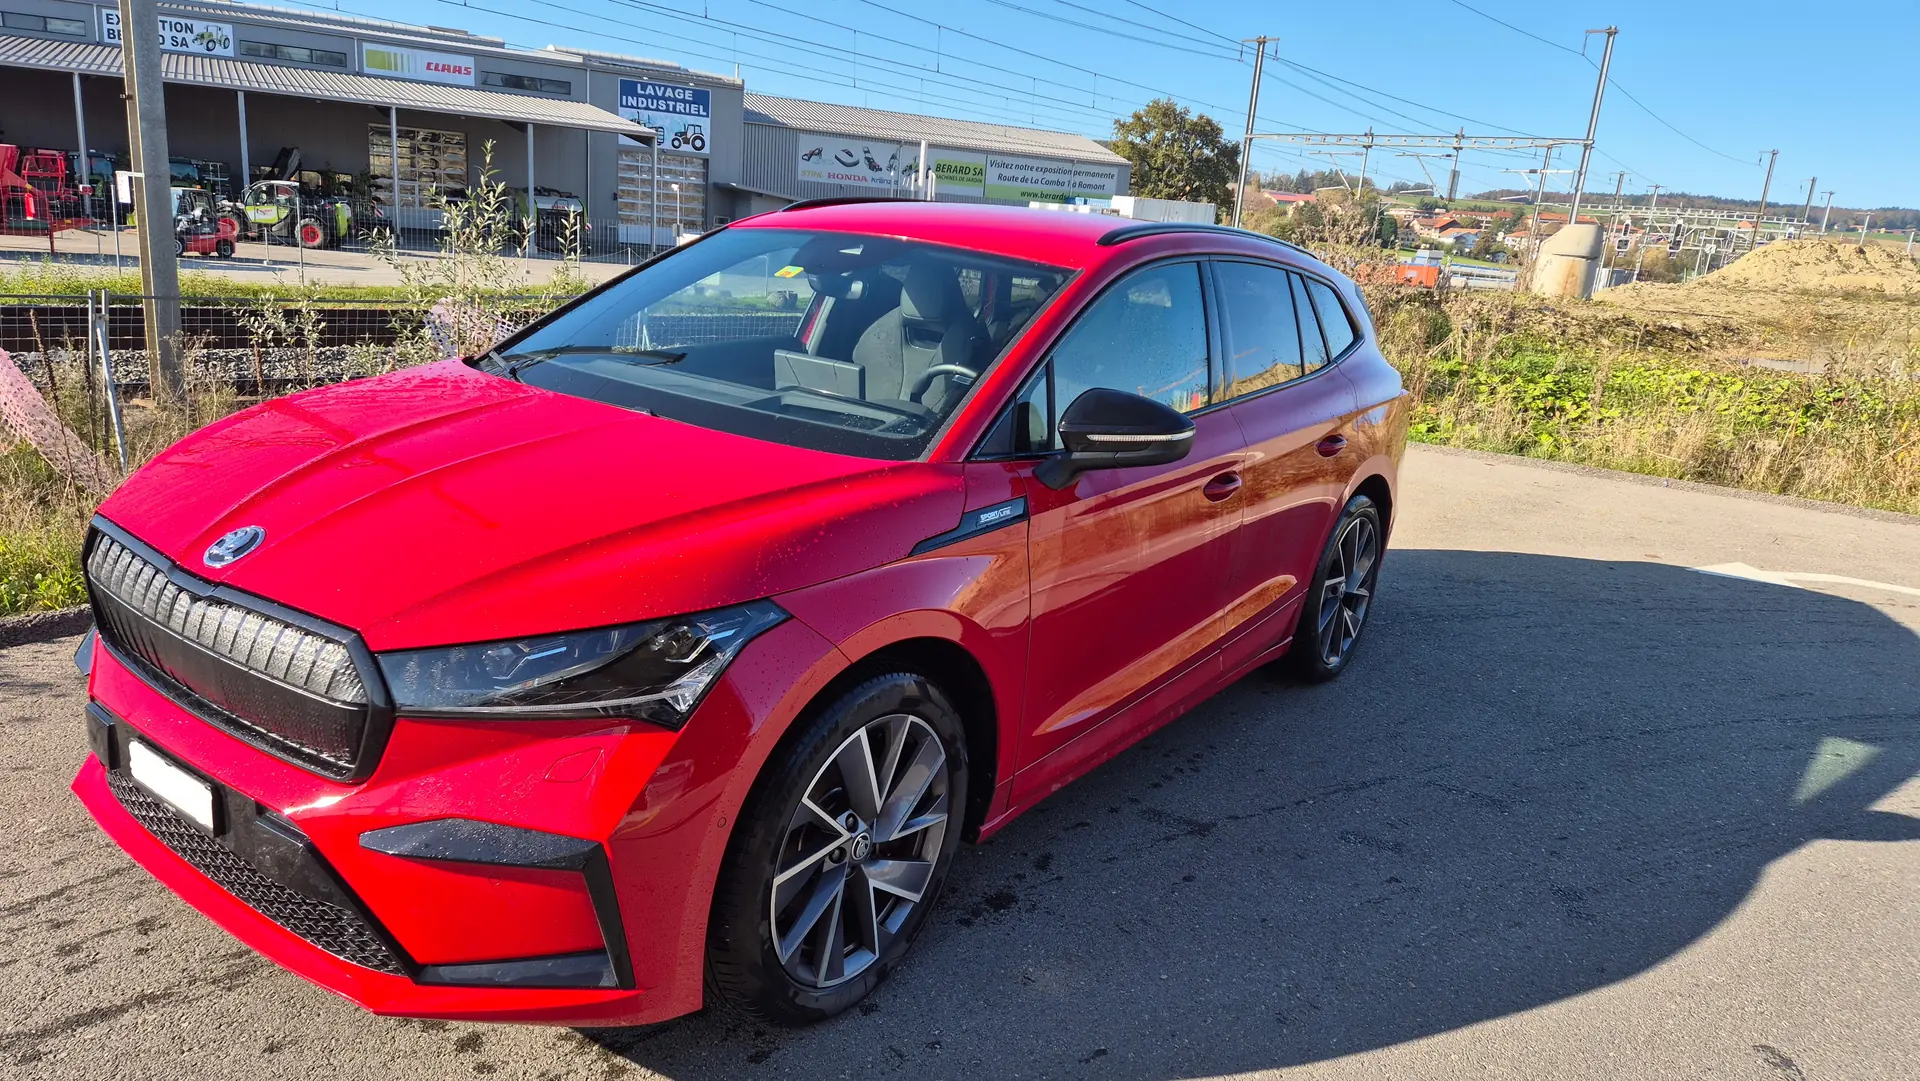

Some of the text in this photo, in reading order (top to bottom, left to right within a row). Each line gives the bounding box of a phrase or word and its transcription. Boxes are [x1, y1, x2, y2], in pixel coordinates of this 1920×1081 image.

[170, 36, 190, 49] SA
[426, 61, 472, 76] CLAAS
[637, 83, 693, 101] LAVAGE
[622, 95, 707, 116] INDUSTRIEL
[827, 172, 868, 183] HONDA
[935, 163, 983, 177] BERARD SA
[989, 160, 1115, 180] Visitez notre exposition permanente
[997, 173, 1019, 183] Route
[1019, 176, 1029, 184] de
[1030, 177, 1039, 185] La
[1077, 181, 1106, 191] Romont
